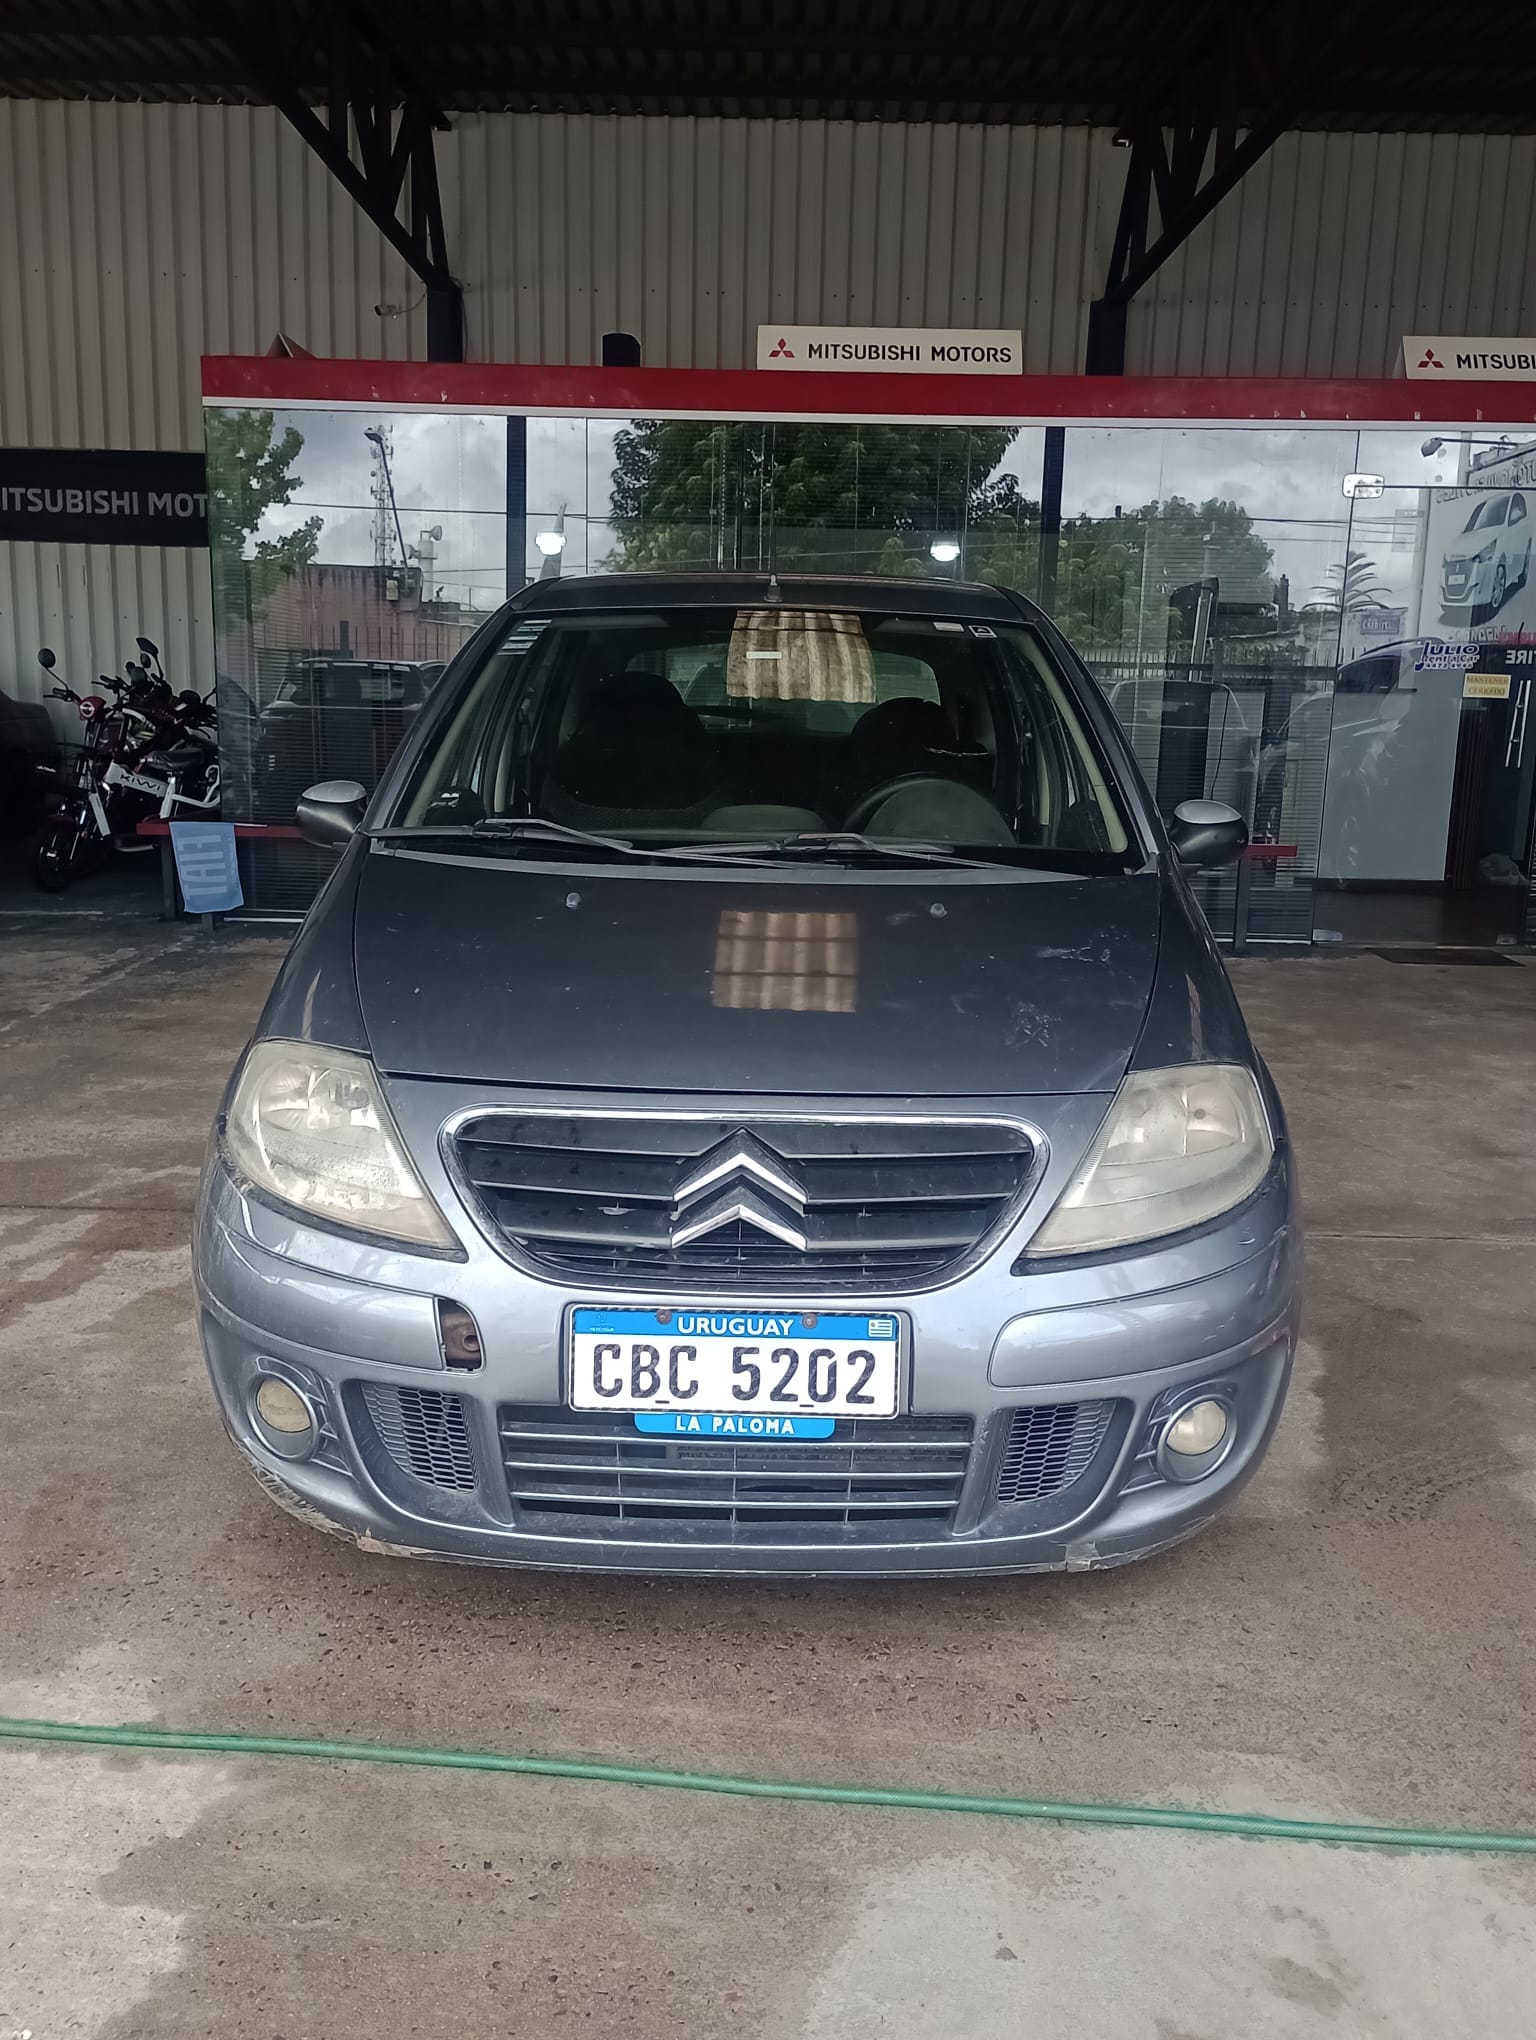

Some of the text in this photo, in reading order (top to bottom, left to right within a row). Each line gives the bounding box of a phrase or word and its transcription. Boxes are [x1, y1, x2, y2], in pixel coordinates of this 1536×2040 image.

[807, 343, 1012, 363] MITSUBISHI MOTORS
[1456, 353, 1536, 369] MITSUBI
[1, 487, 208, 518] ITSUBISHI MOT
[1414, 641, 1479, 671] JULIO
[677, 1316, 794, 1337] URUGUAY
[593, 1343, 877, 1405] CBC 5202
[675, 1415, 795, 1435] LA PALOMA
